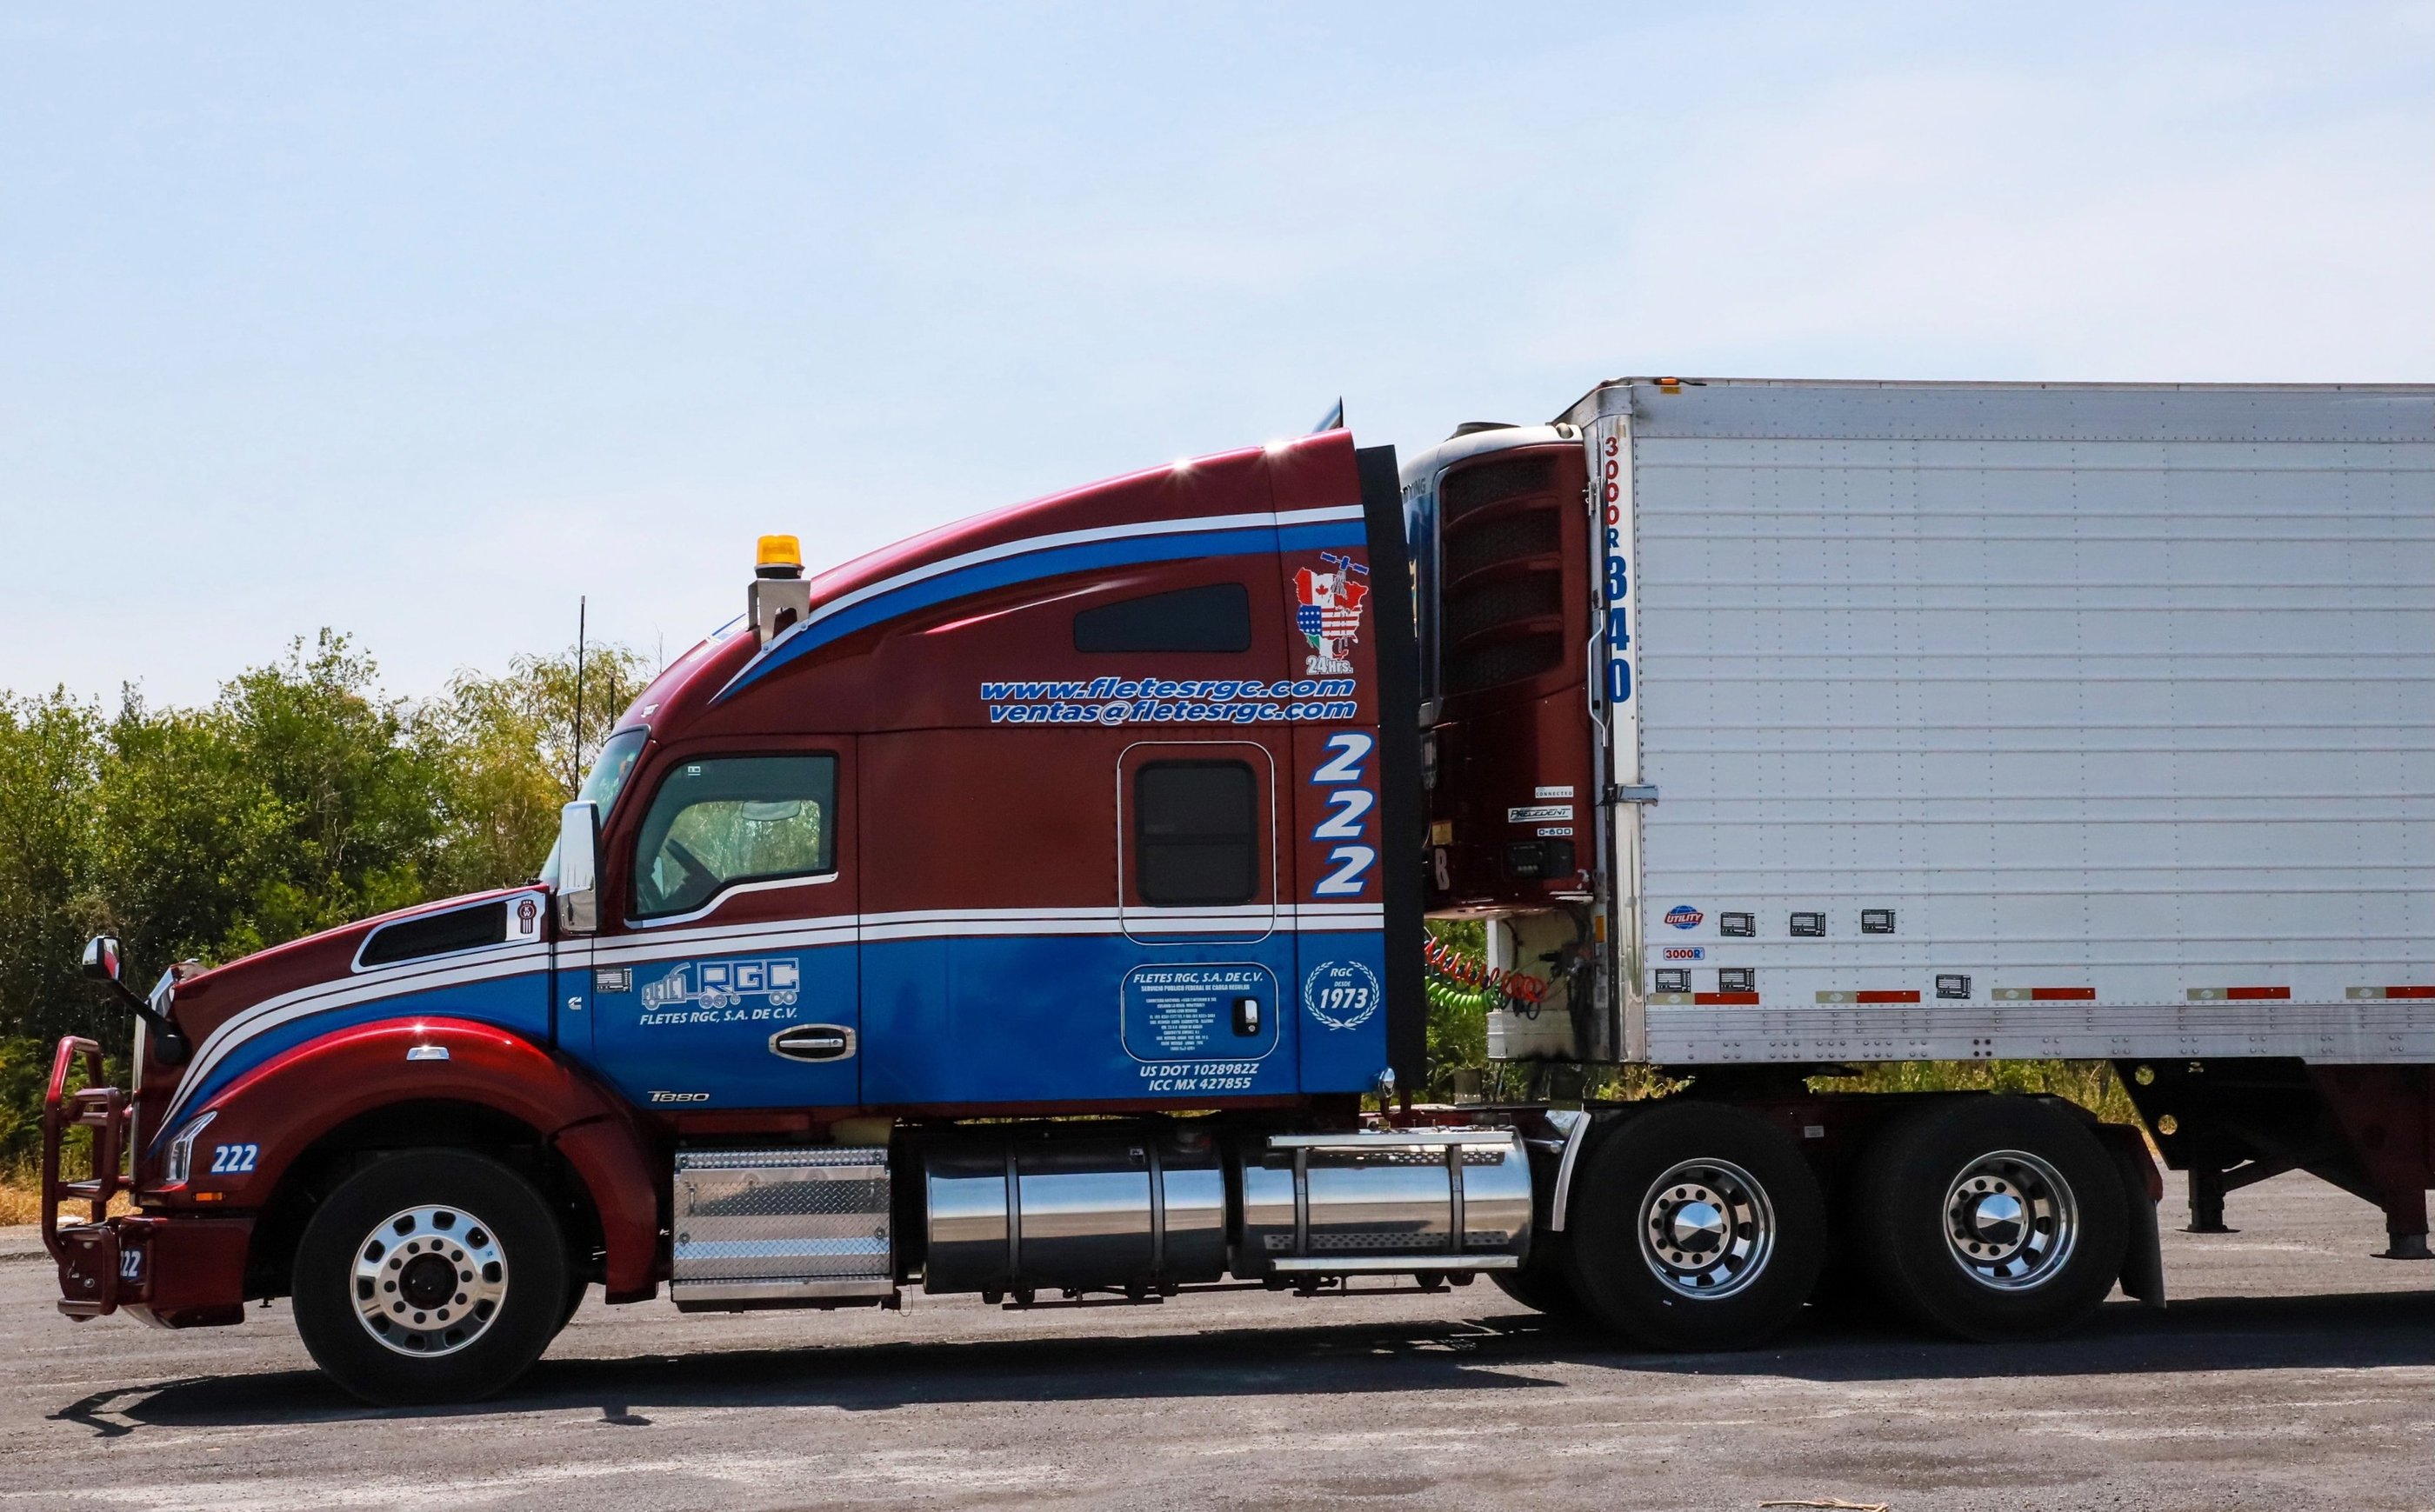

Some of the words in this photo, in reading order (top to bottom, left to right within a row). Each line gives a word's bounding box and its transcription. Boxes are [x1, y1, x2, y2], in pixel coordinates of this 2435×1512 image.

[981, 676, 1356, 700] www.fletesrgc.com
[990, 700, 1357, 725] ventas@fletesrgc.com
[1666, 914, 1702, 923] UTILITY
[1665, 949, 1701, 958] 3000R
[697, 957, 800, 996] RGC
[1133, 973, 1173, 983] FLETES
[1174, 973, 1199, 984] RGC,
[1202, 972, 1223, 982] S.A.
[1224, 972, 1241, 982] DE
[1242, 971, 1264, 982] C.V.
[1330, 968, 1353, 977] RGC
[1320, 988, 1369, 1009] 1973
[640, 1012, 688, 1025] FLETES
[690, 1011, 720, 1023] RGC,
[724, 1010, 748, 1021] S.A.
[751, 1009, 771, 1020] DE
[773, 1008, 797, 1019] C.V.
[1139, 1066, 1157, 1077] US
[1159, 1065, 1191, 1077] DOT
[1148, 1079, 1172, 1091] ICC
[1174, 1078, 1197, 1090] MX
[1199, 1077, 1252, 1089] 427855
[647, 1090, 710, 1102] T880
[211, 1144, 258, 1173] 222
